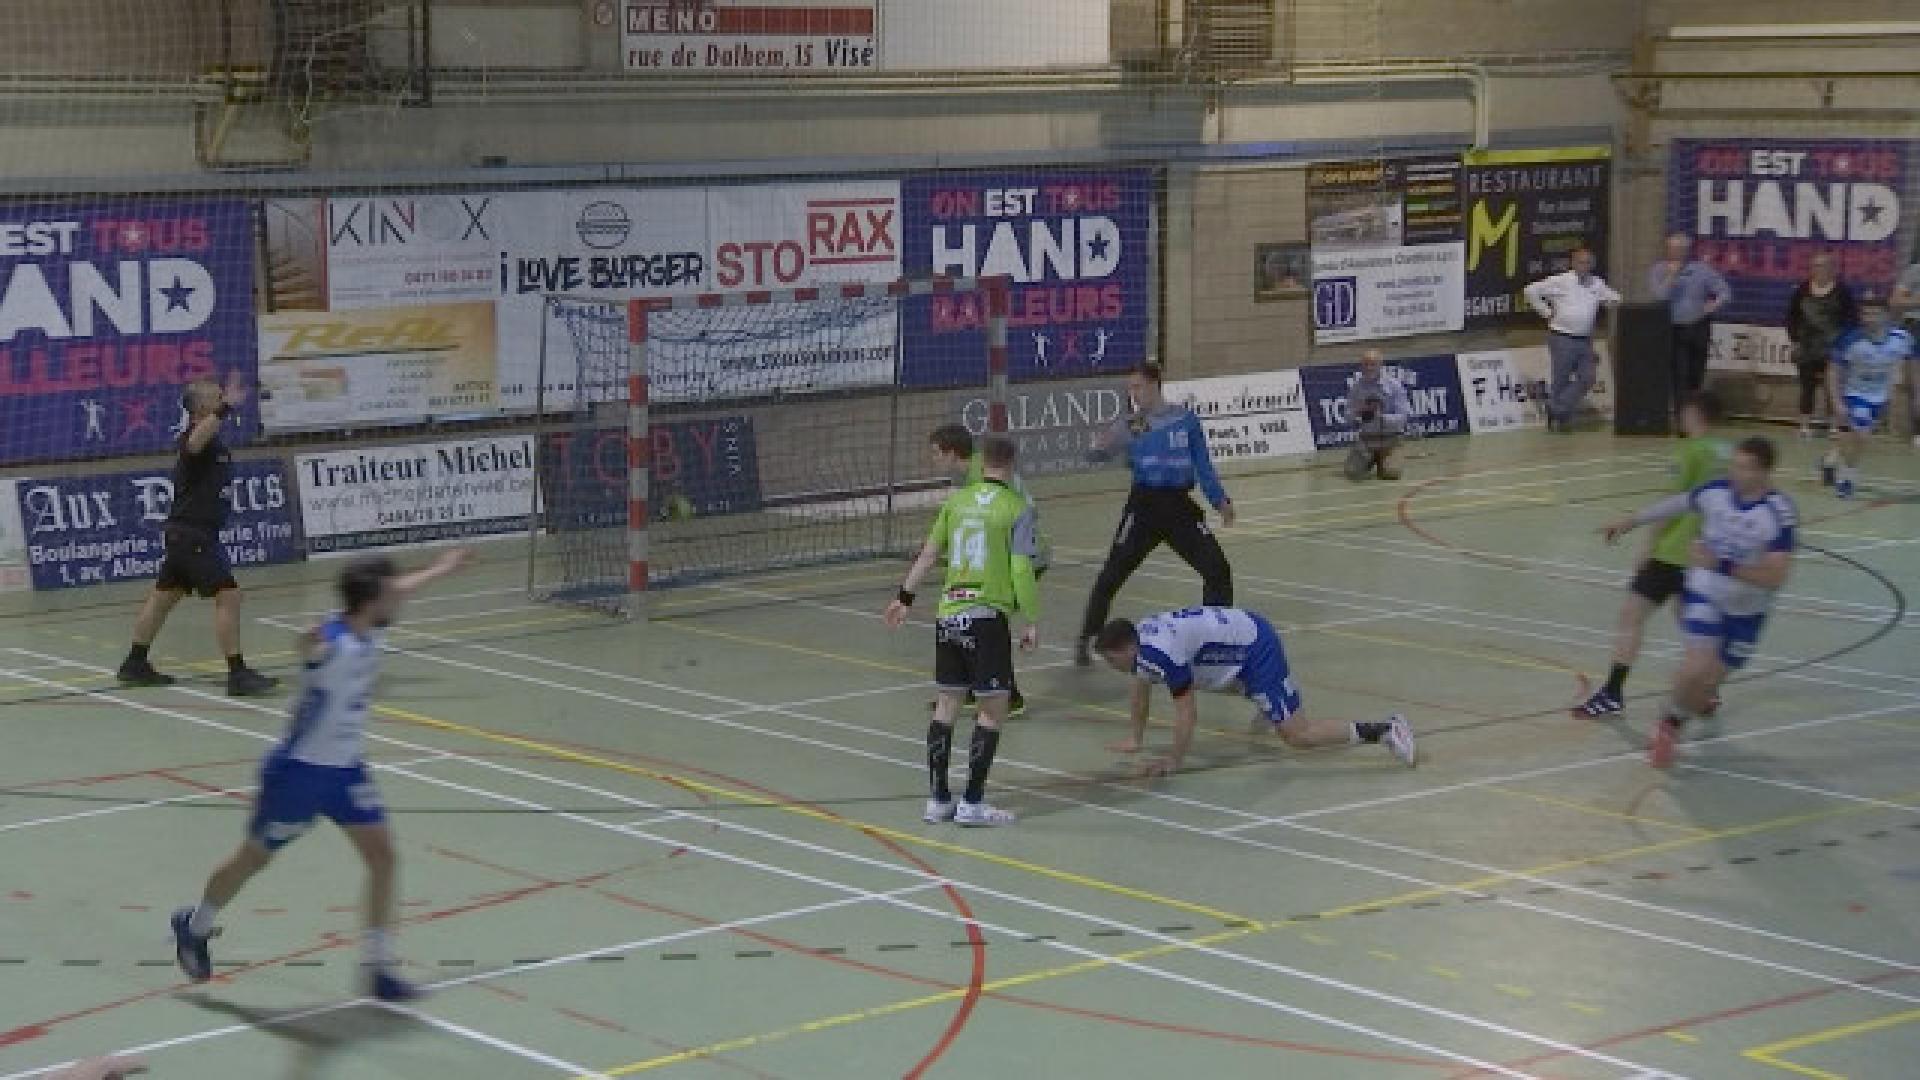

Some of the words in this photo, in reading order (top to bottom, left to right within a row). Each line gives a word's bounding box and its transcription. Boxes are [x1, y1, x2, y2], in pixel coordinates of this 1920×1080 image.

[629, 48, 664, 67] rue
[671, 42, 697, 67] de
[825, 38, 874, 67] Visé
[1469, 164, 1603, 194] RESTAURANT
[1752, 150, 1808, 175] EST
[984, 188, 1038, 217] EST
[1697, 179, 1900, 241] HAND
[94, 216, 209, 252] TOUS
[932, 216, 1120, 283] HAND
[517, 256, 583, 294] LOVE
[588, 251, 703, 288] BURGER
[304, 454, 427, 488] Traiteur
[436, 441, 532, 479] Michel
[25, 484, 117, 535] Aux
[227, 545, 267, 566] Visé
